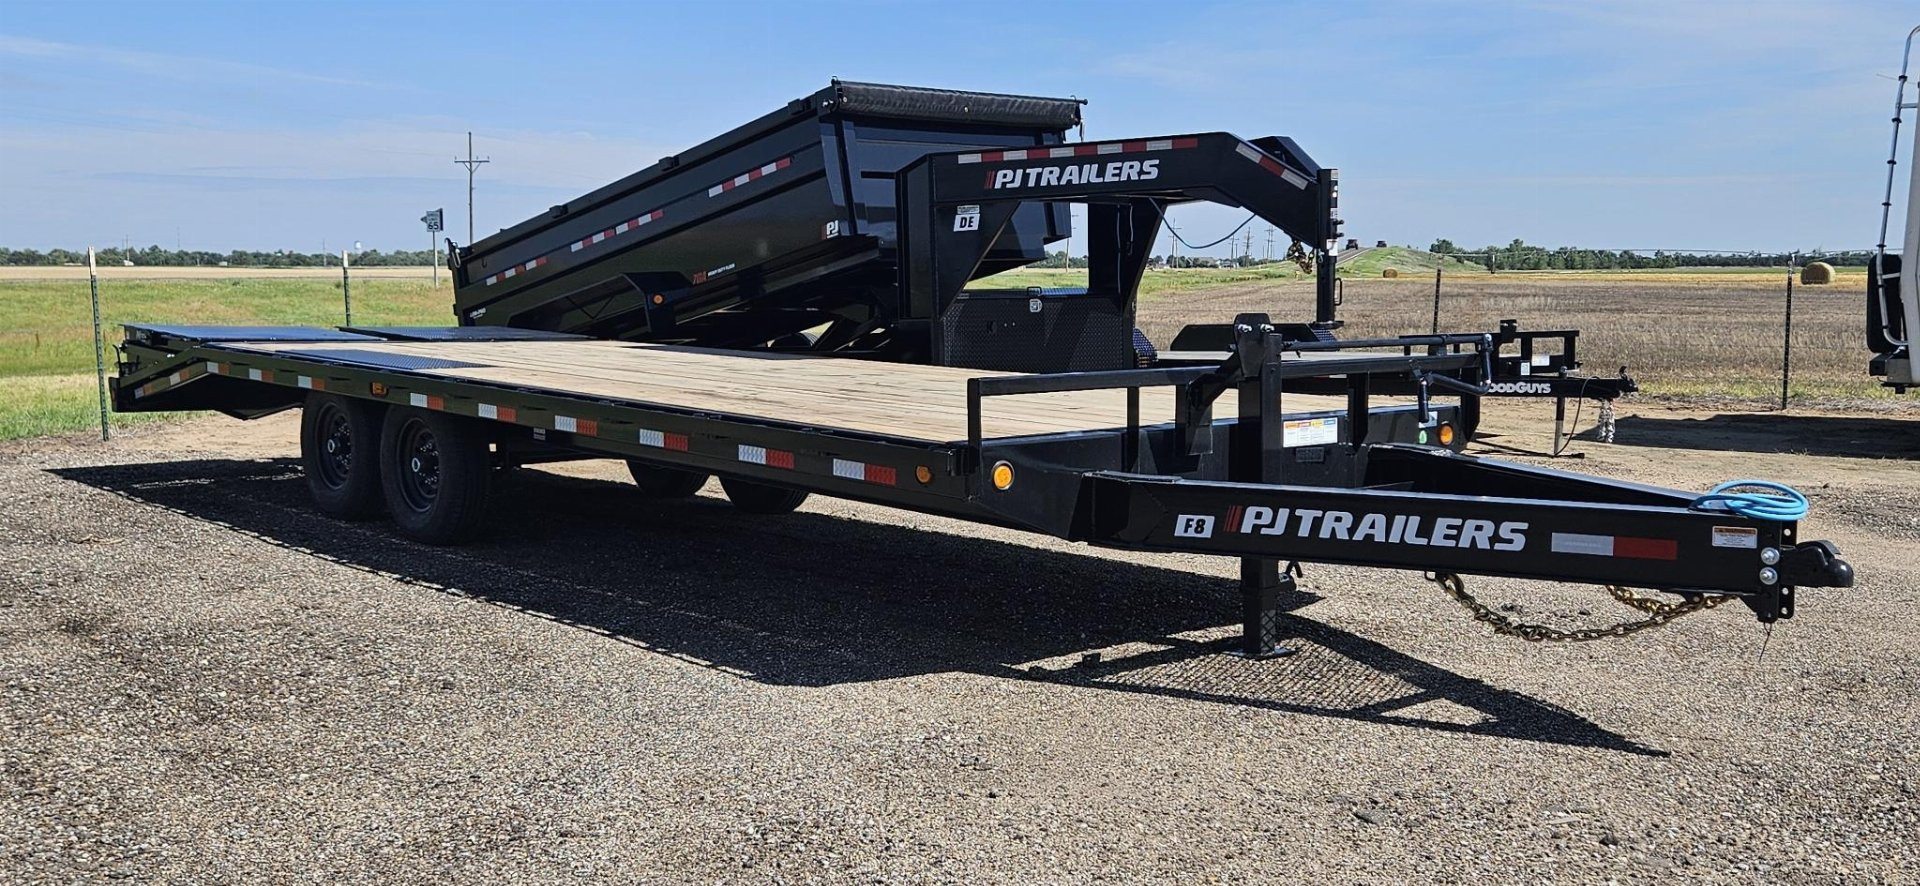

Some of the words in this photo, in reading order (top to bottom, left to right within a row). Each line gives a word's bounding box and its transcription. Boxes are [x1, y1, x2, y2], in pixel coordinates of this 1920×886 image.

[994, 169, 1023, 189] PJ
[1026, 159, 1160, 187] TRAILERS
[428, 221, 439, 230] 65
[826, 219, 839, 235] PJ
[959, 216, 975, 229] DE
[1487, 381, 1552, 394] OODGUYS
[1183, 518, 1206, 534] F8
[1240, 505, 1290, 536] PJ
[1294, 508, 1529, 551] TRAILERS
